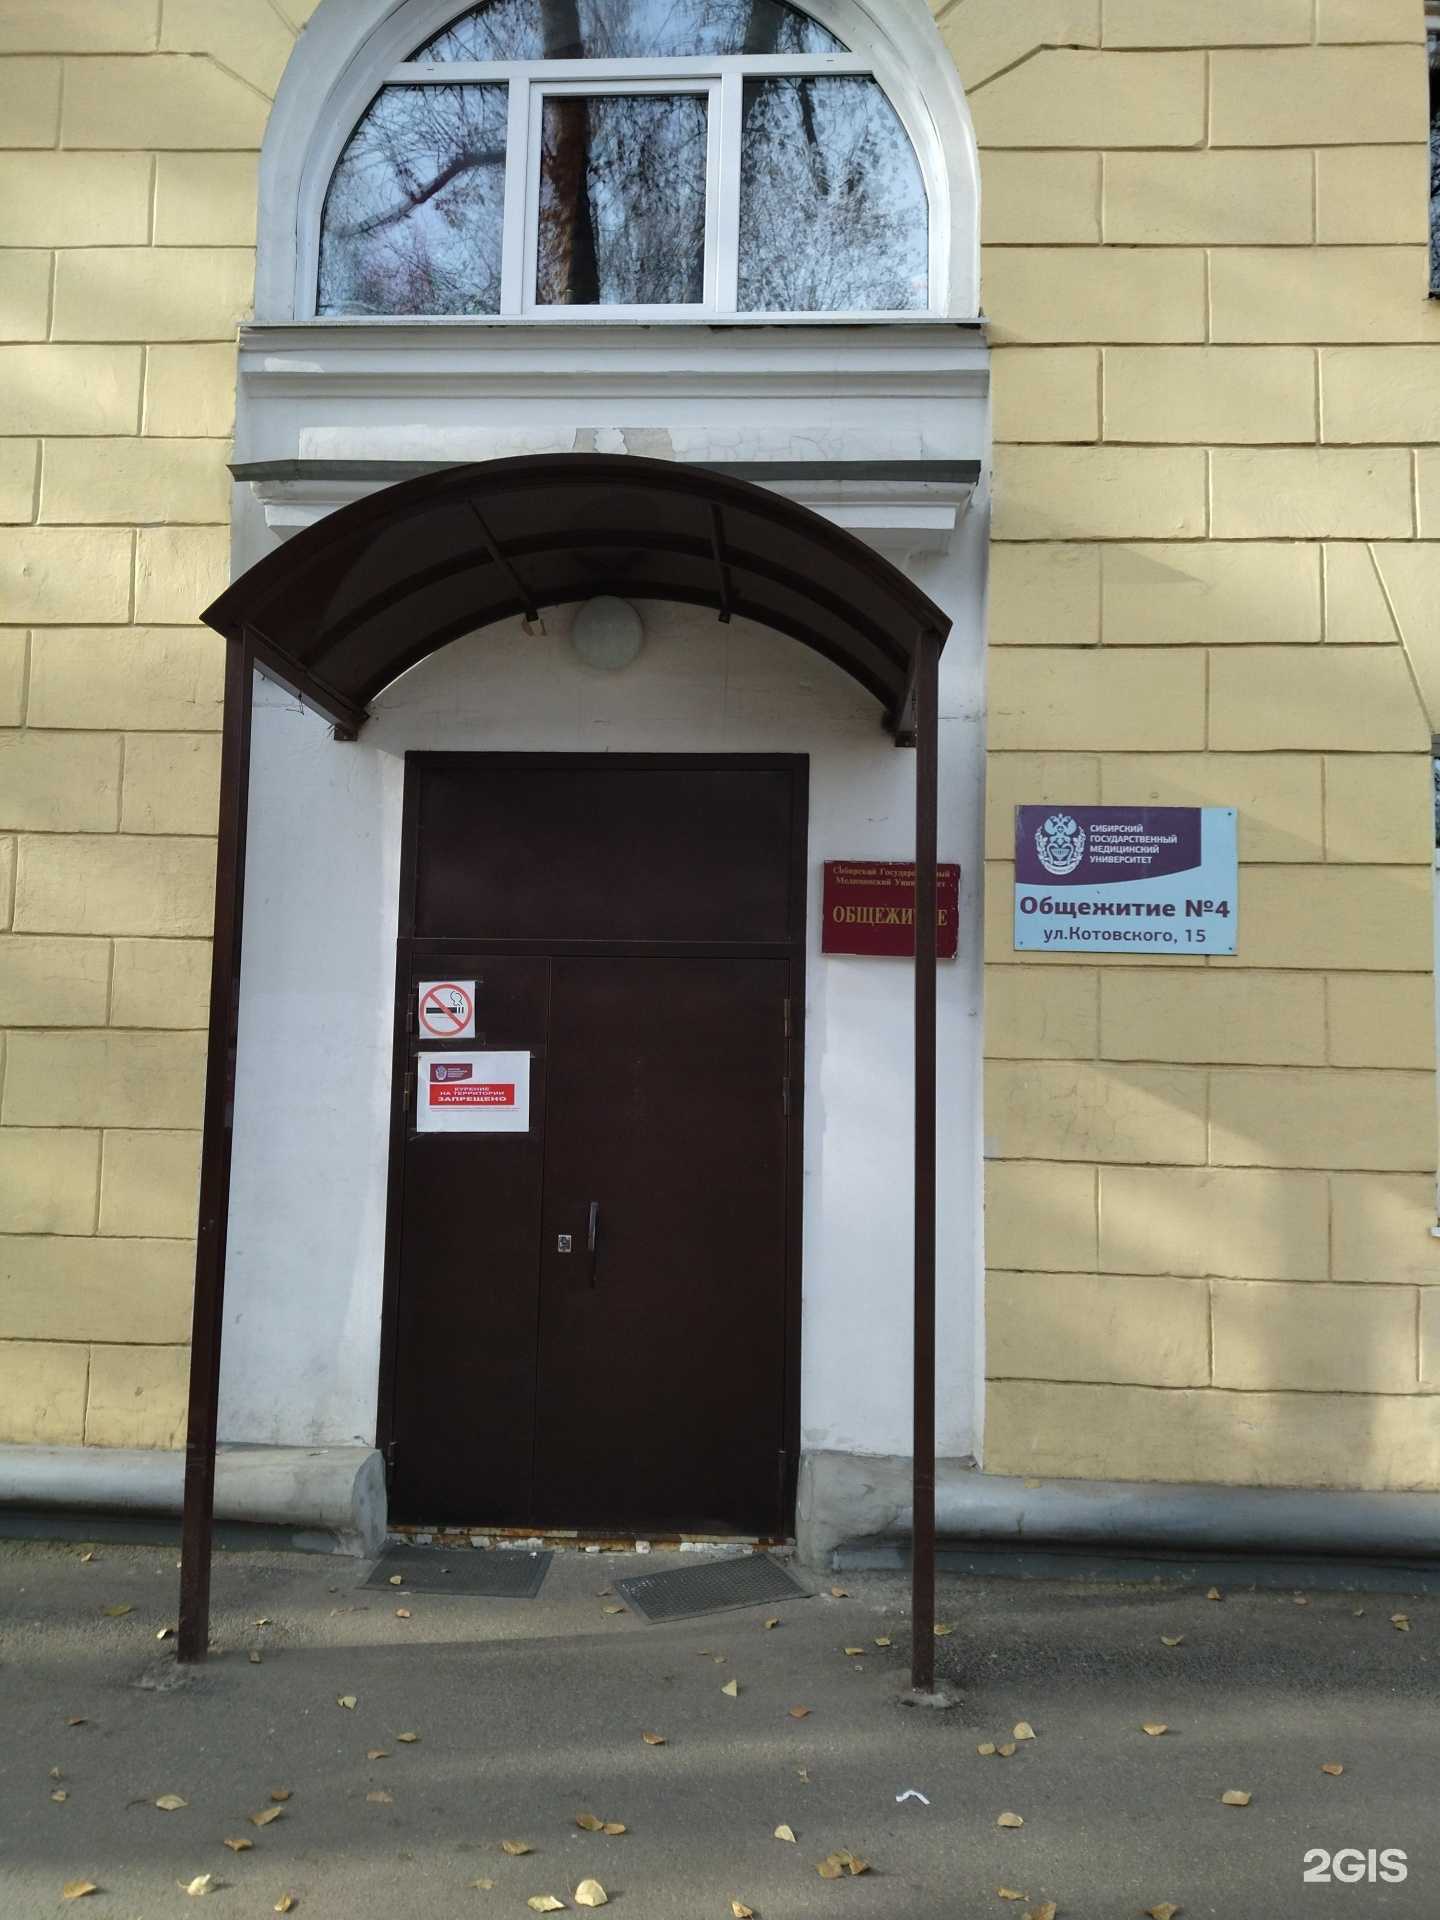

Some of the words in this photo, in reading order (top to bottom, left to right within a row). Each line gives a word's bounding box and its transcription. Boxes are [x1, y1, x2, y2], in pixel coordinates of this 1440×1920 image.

[1090, 824, 1144, 833] СИБИРСКИЙ
[1090, 834, 1178, 844] ГОСУДАРСТВЕННЫЙ
[1090, 845, 1160, 855] МЕДИЦИНСКИЙ
[1089, 855, 1153, 864] УНИВЕРСИТЕТ
[1020, 896, 1176, 918] Общежитие
[1185, 899, 1230, 918] №4
[832, 905, 949, 926] ОБЩЕЖИЕ
[1043, 926, 1178, 944] ул.Котовского,
[1185, 929, 1206, 943] 15
